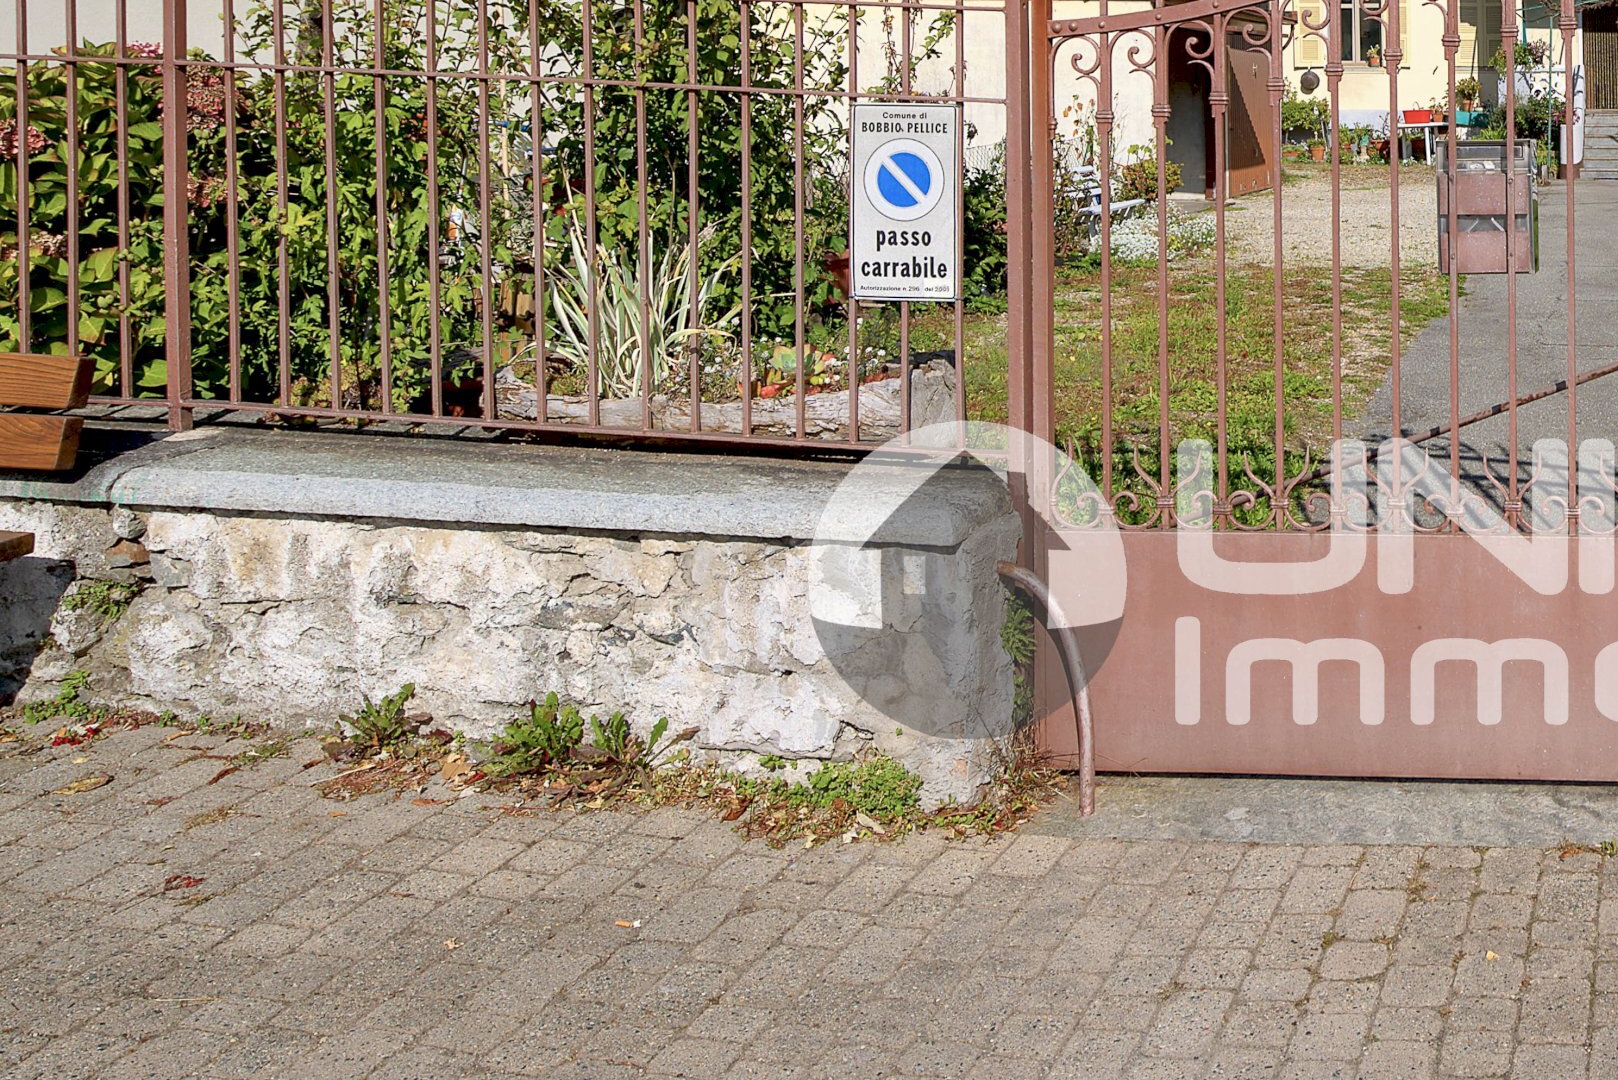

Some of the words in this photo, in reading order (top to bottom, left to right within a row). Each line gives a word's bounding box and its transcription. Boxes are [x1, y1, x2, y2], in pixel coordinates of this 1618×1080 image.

[861, 121, 901, 133] BOBBIO
[907, 122, 948, 134] PELLICE
[876, 229, 931, 251] passo
[861, 256, 947, 278] carrabile
